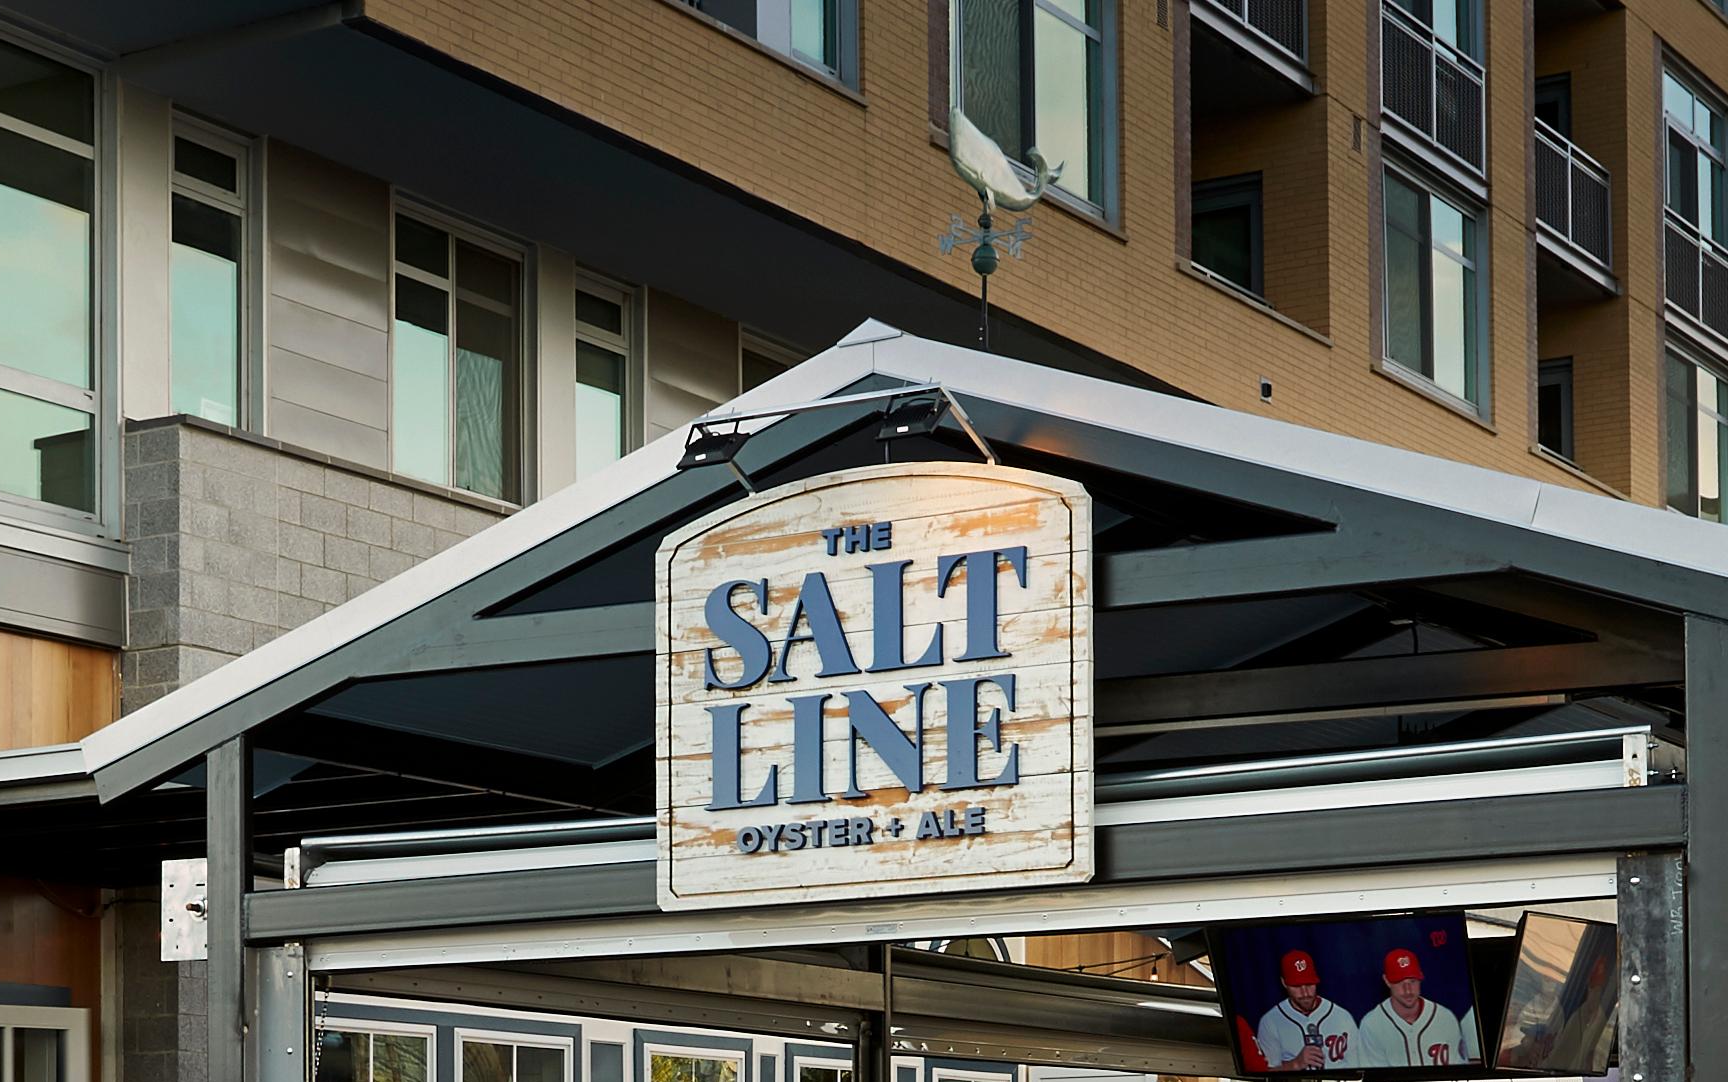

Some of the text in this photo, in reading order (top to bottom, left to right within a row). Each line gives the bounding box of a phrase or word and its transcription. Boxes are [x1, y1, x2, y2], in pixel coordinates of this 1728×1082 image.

[822, 520, 893, 556] THE
[704, 546, 1028, 690] SALT
[704, 673, 1020, 812] LINE
[735, 817, 872, 854] OYSTER
[916, 807, 986, 840] ALE
